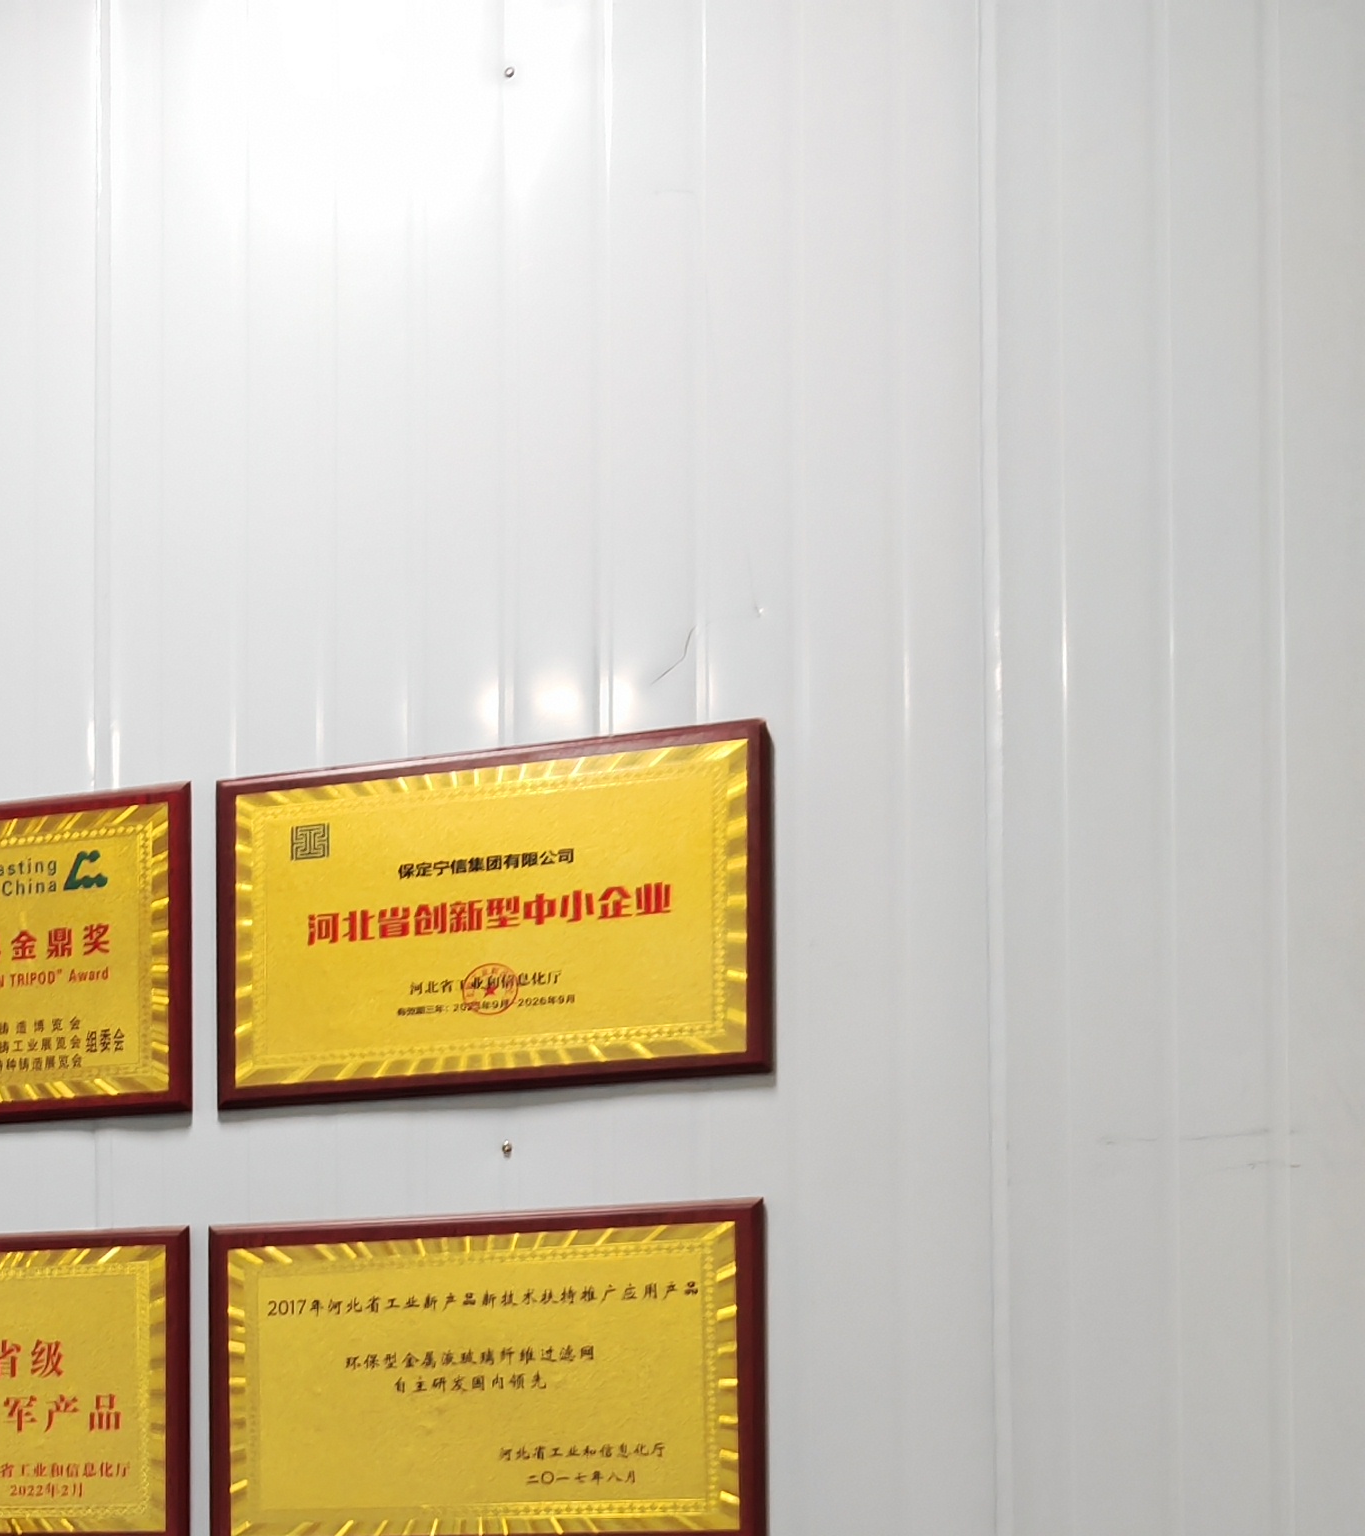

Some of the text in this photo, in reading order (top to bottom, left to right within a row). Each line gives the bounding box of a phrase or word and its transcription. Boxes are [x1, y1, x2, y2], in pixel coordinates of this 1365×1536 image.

[398, 848, 574, 879] 保定宁信集团有限公司
[1, 880, 57, 897] China
[307, 882, 672, 946] 河北省创新型中小企业
[69, 966, 109, 982] Award
[85, 1028, 125, 1053] 组委会
[267, 1280, 700, 1318] 2017年河北省工业新产品新技术扶持推广应用产品
[345, 1345, 595, 1371] 环保型金属液玻璃纤维过滤网
[393, 1372, 548, 1394] 自主研发国内领先
[499, 1442, 666, 1462] 河北省工业和信息化厅
[9, 1482, 85, 1499] 2022年2月
